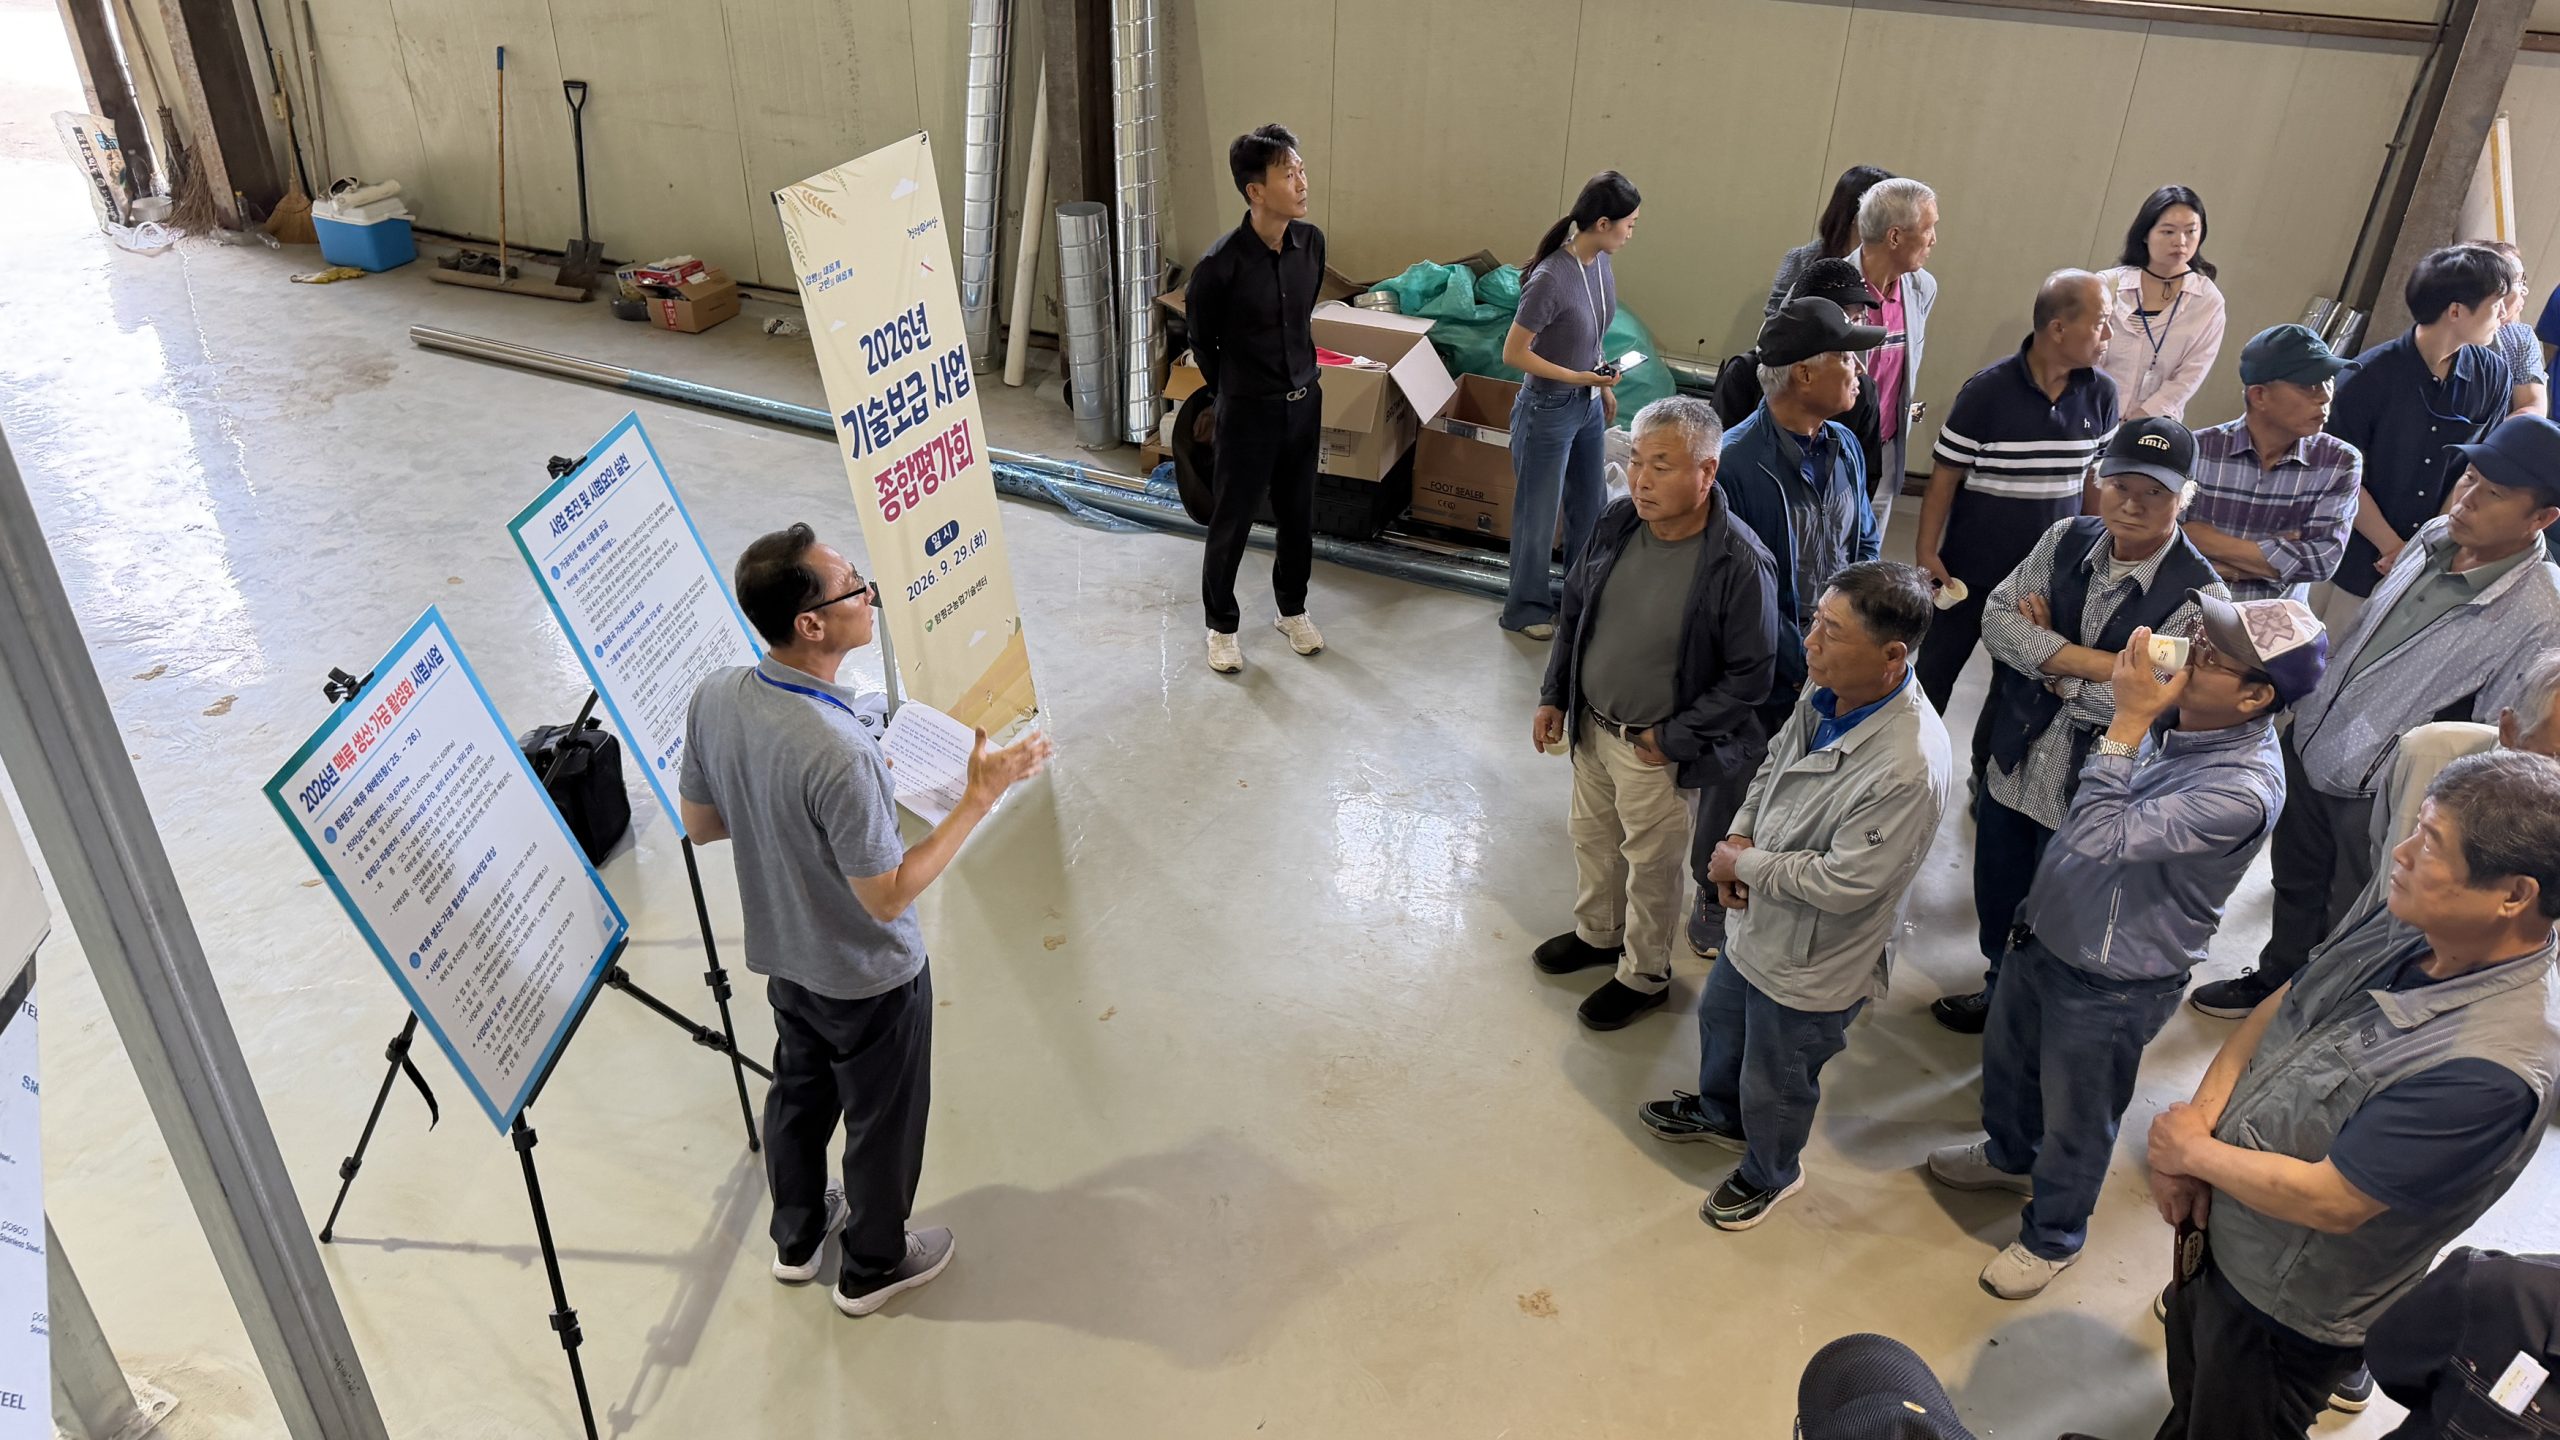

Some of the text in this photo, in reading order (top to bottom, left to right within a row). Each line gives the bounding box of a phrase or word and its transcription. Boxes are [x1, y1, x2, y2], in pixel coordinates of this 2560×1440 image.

[859, 302, 932, 375] 2026년
[841, 344, 970, 459] 기술보급 사업
[875, 418, 974, 523] 종합평가회
[2137, 438, 2169, 451] amis
[549, 511, 569, 538] 사업
[563, 497, 584, 522] 추진
[578, 489, 592, 510] 및
[587, 465, 618, 501] 시범요인
[1430, 481, 1485, 500] FOOT SEALER
[906, 529, 987, 601] 2026. 9. 29.(화)
[934, 575, 988, 624] 함평군농업기술센터
[299, 643, 444, 814] 2026년 맥류 생산·가공 활성화 시범사업
[334, 804, 356, 831] 함평군
[352, 790, 367, 808] 맥류
[345, 775, 410, 852] 전라남도 파종면적 19,674ha
[364, 858, 382, 880] 함평군
[379, 835, 400, 862] 파종면적
[418, 935, 432, 953] 맥류
[450, 884, 469, 910] 활성화
[466, 858, 488, 889] 시범사업
[484, 845, 497, 863] 대상
[429, 948, 448, 975] 사업개요
[1, 1220, 29, 1237] posco
